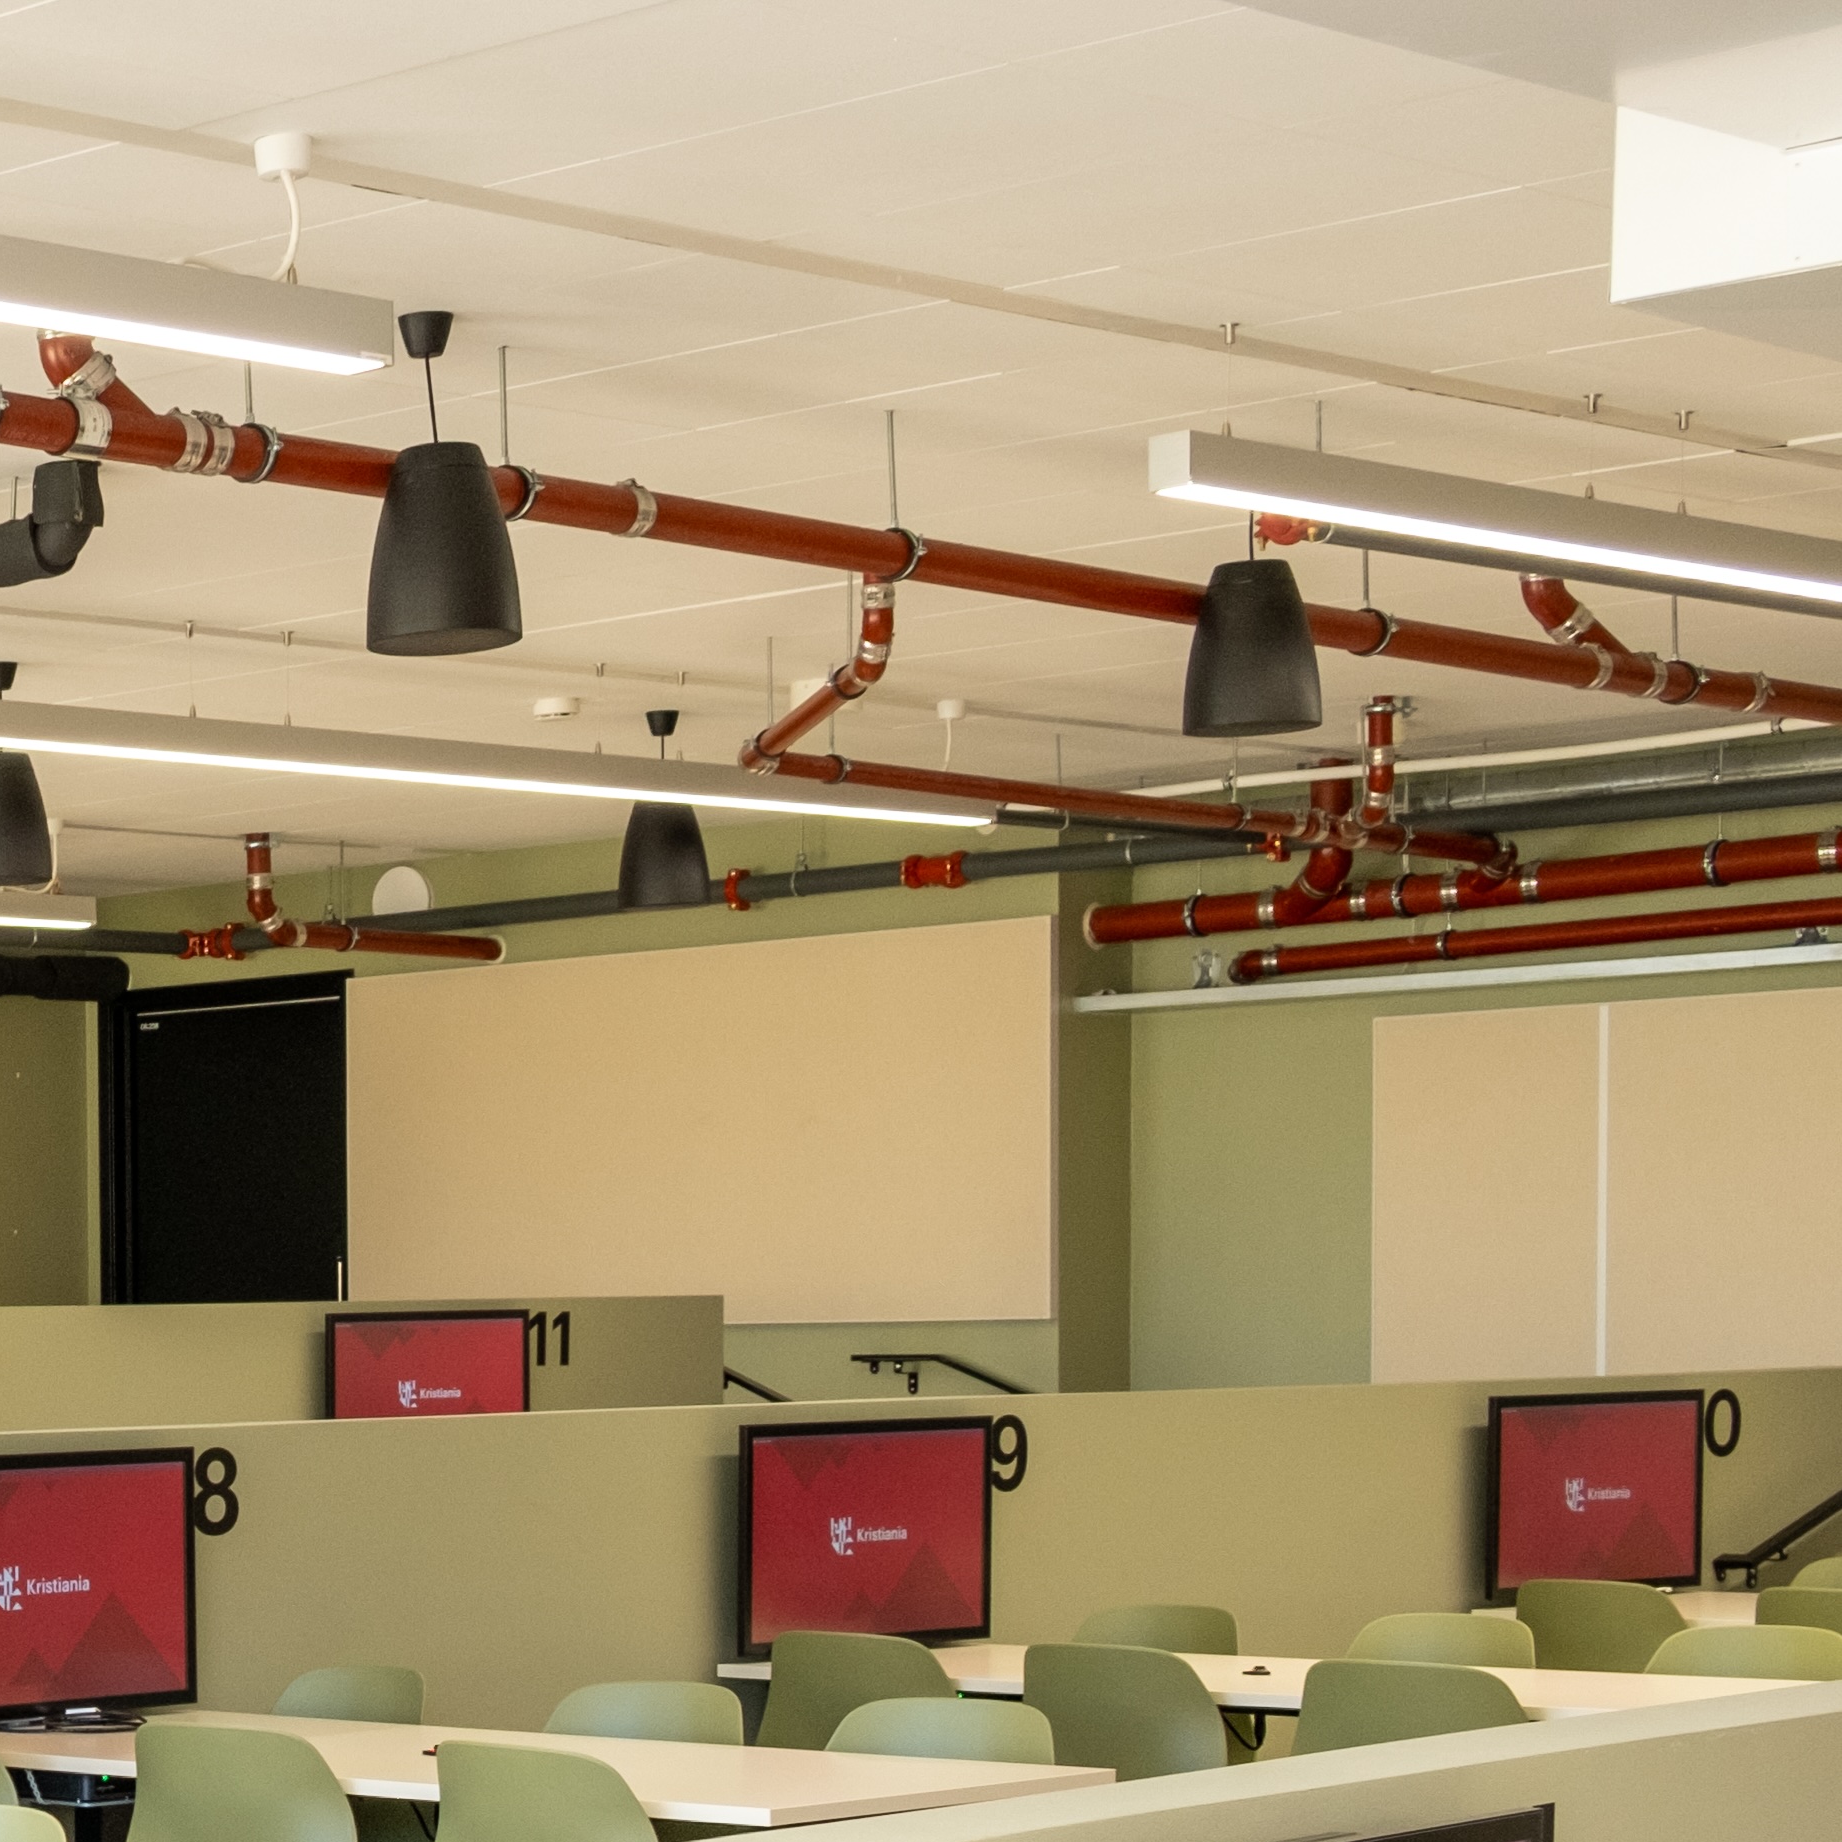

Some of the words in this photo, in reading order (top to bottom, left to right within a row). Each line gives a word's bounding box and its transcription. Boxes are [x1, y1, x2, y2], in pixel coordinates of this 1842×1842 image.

[528, 1311, 571, 1367] 11
[991, 1414, 1028, 1492] 9
[194, 1447, 239, 1536] 8
[856, 1526, 908, 1542] Kristiania
[26, 1575, 90, 1597] Kristiania
